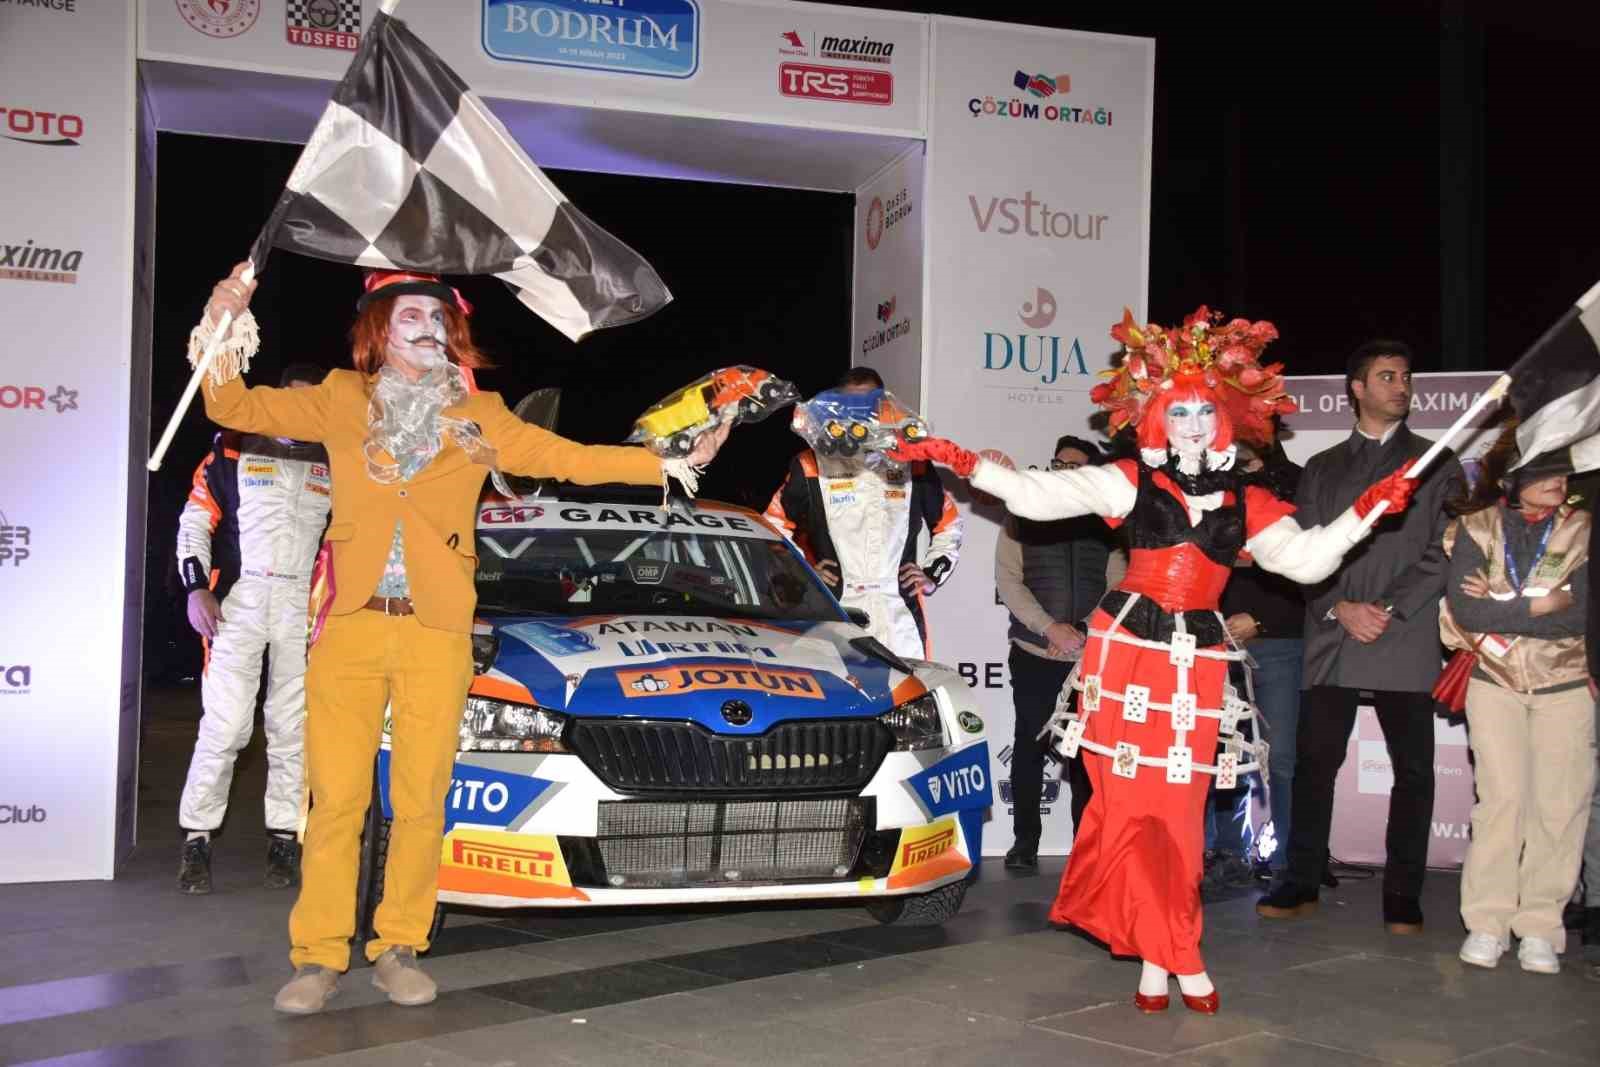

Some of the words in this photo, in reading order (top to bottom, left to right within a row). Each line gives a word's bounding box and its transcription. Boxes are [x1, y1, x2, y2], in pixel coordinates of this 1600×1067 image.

[290, 29, 357, 49] TOSFED
[504, 4, 679, 51] BODRUM
[821, 36, 894, 56] maxima
[968, 96, 1039, 118] ÇÖZÜM
[1044, 106, 1112, 126] ORTAĞI
[0, 239, 83, 271] xima
[984, 331, 1088, 384] DUJA
[1008, 392, 1065, 404] HOTELS
[559, 508, 755, 532] GARAGE
[598, 620, 759, 637] ATAMAN
[677, 669, 814, 693] JOTUN
[0, 805, 46, 824] Club
[452, 838, 554, 878] PIRELLI
[902, 827, 954, 868] PIRELLI
